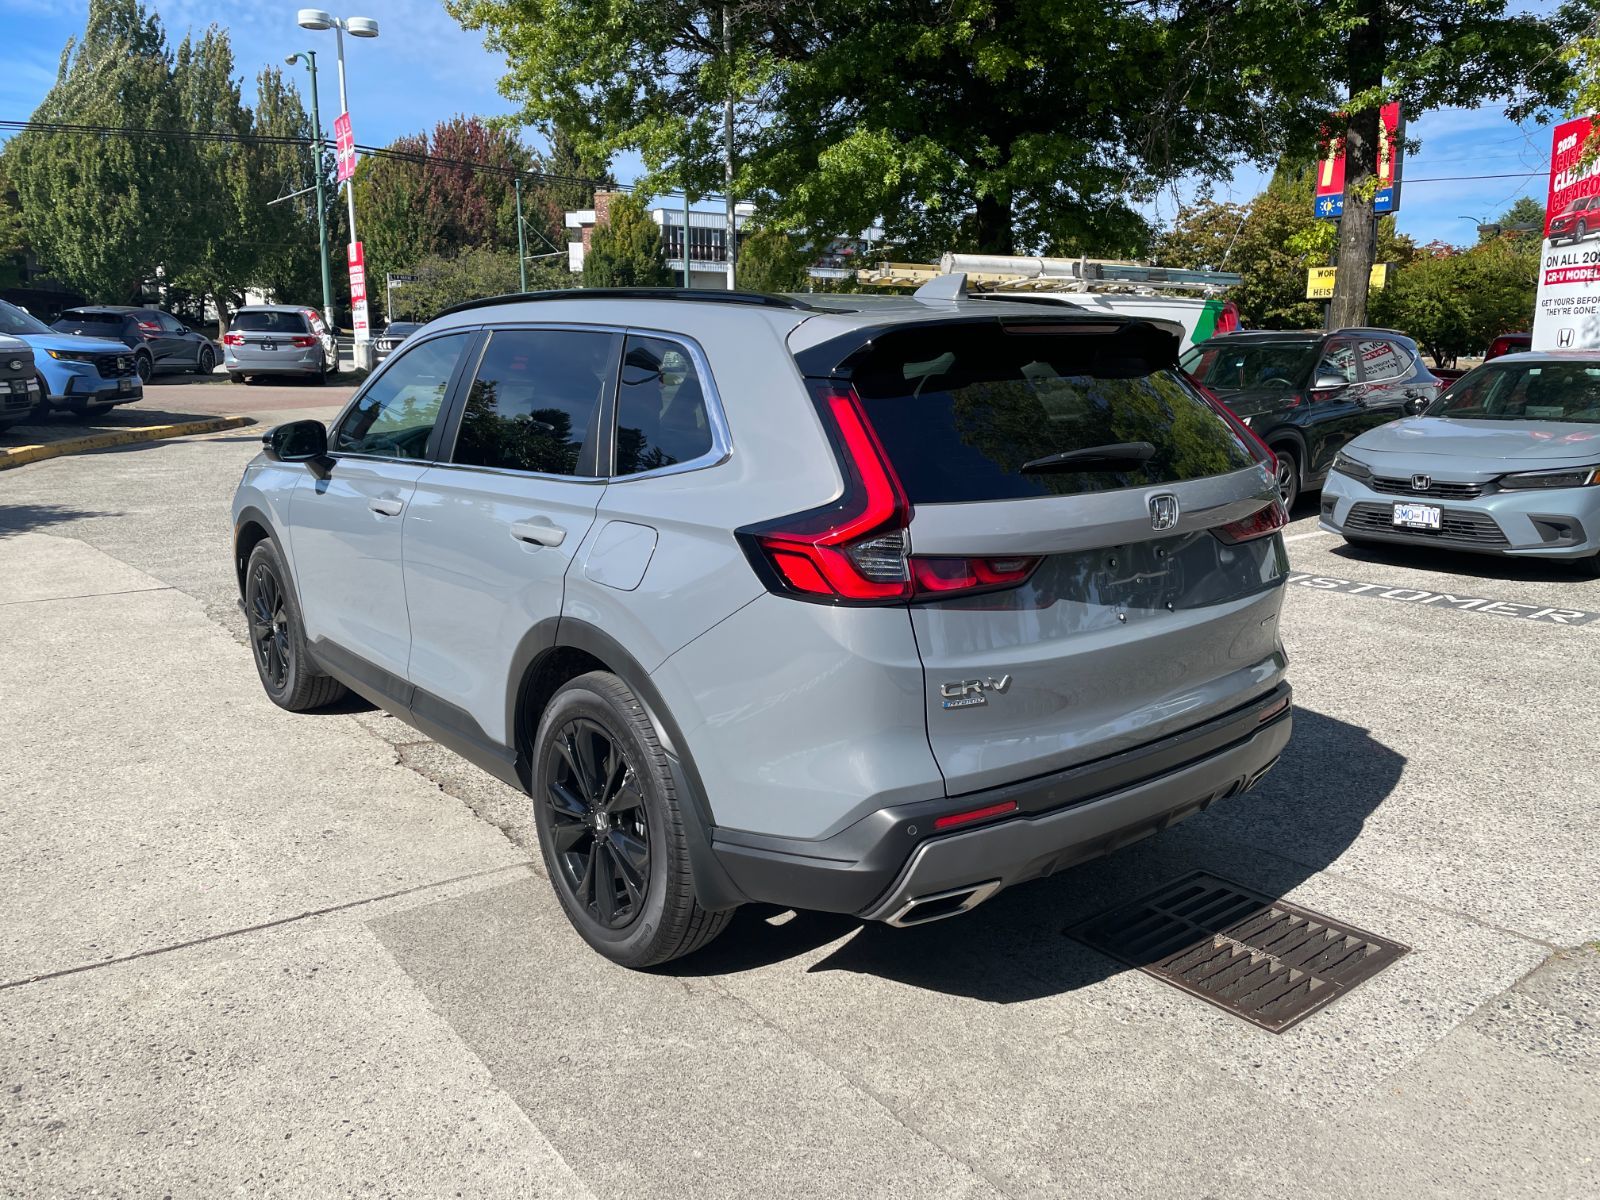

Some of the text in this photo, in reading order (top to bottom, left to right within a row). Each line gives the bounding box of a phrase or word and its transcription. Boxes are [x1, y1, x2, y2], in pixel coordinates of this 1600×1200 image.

[1557, 132, 1578, 155] 2026
[1546, 255, 1559, 268] ON
[1560, 252, 1579, 267] ALL
[1317, 269, 1336, 278] WOR
[1547, 271, 1566, 282] CR-V
[1541, 299, 1552, 307] GET
[1554, 297, 1575, 306] YOURS
[1546, 305, 1599, 316] THEY'RE GONE.
[941, 674, 1010, 697] CR-V
